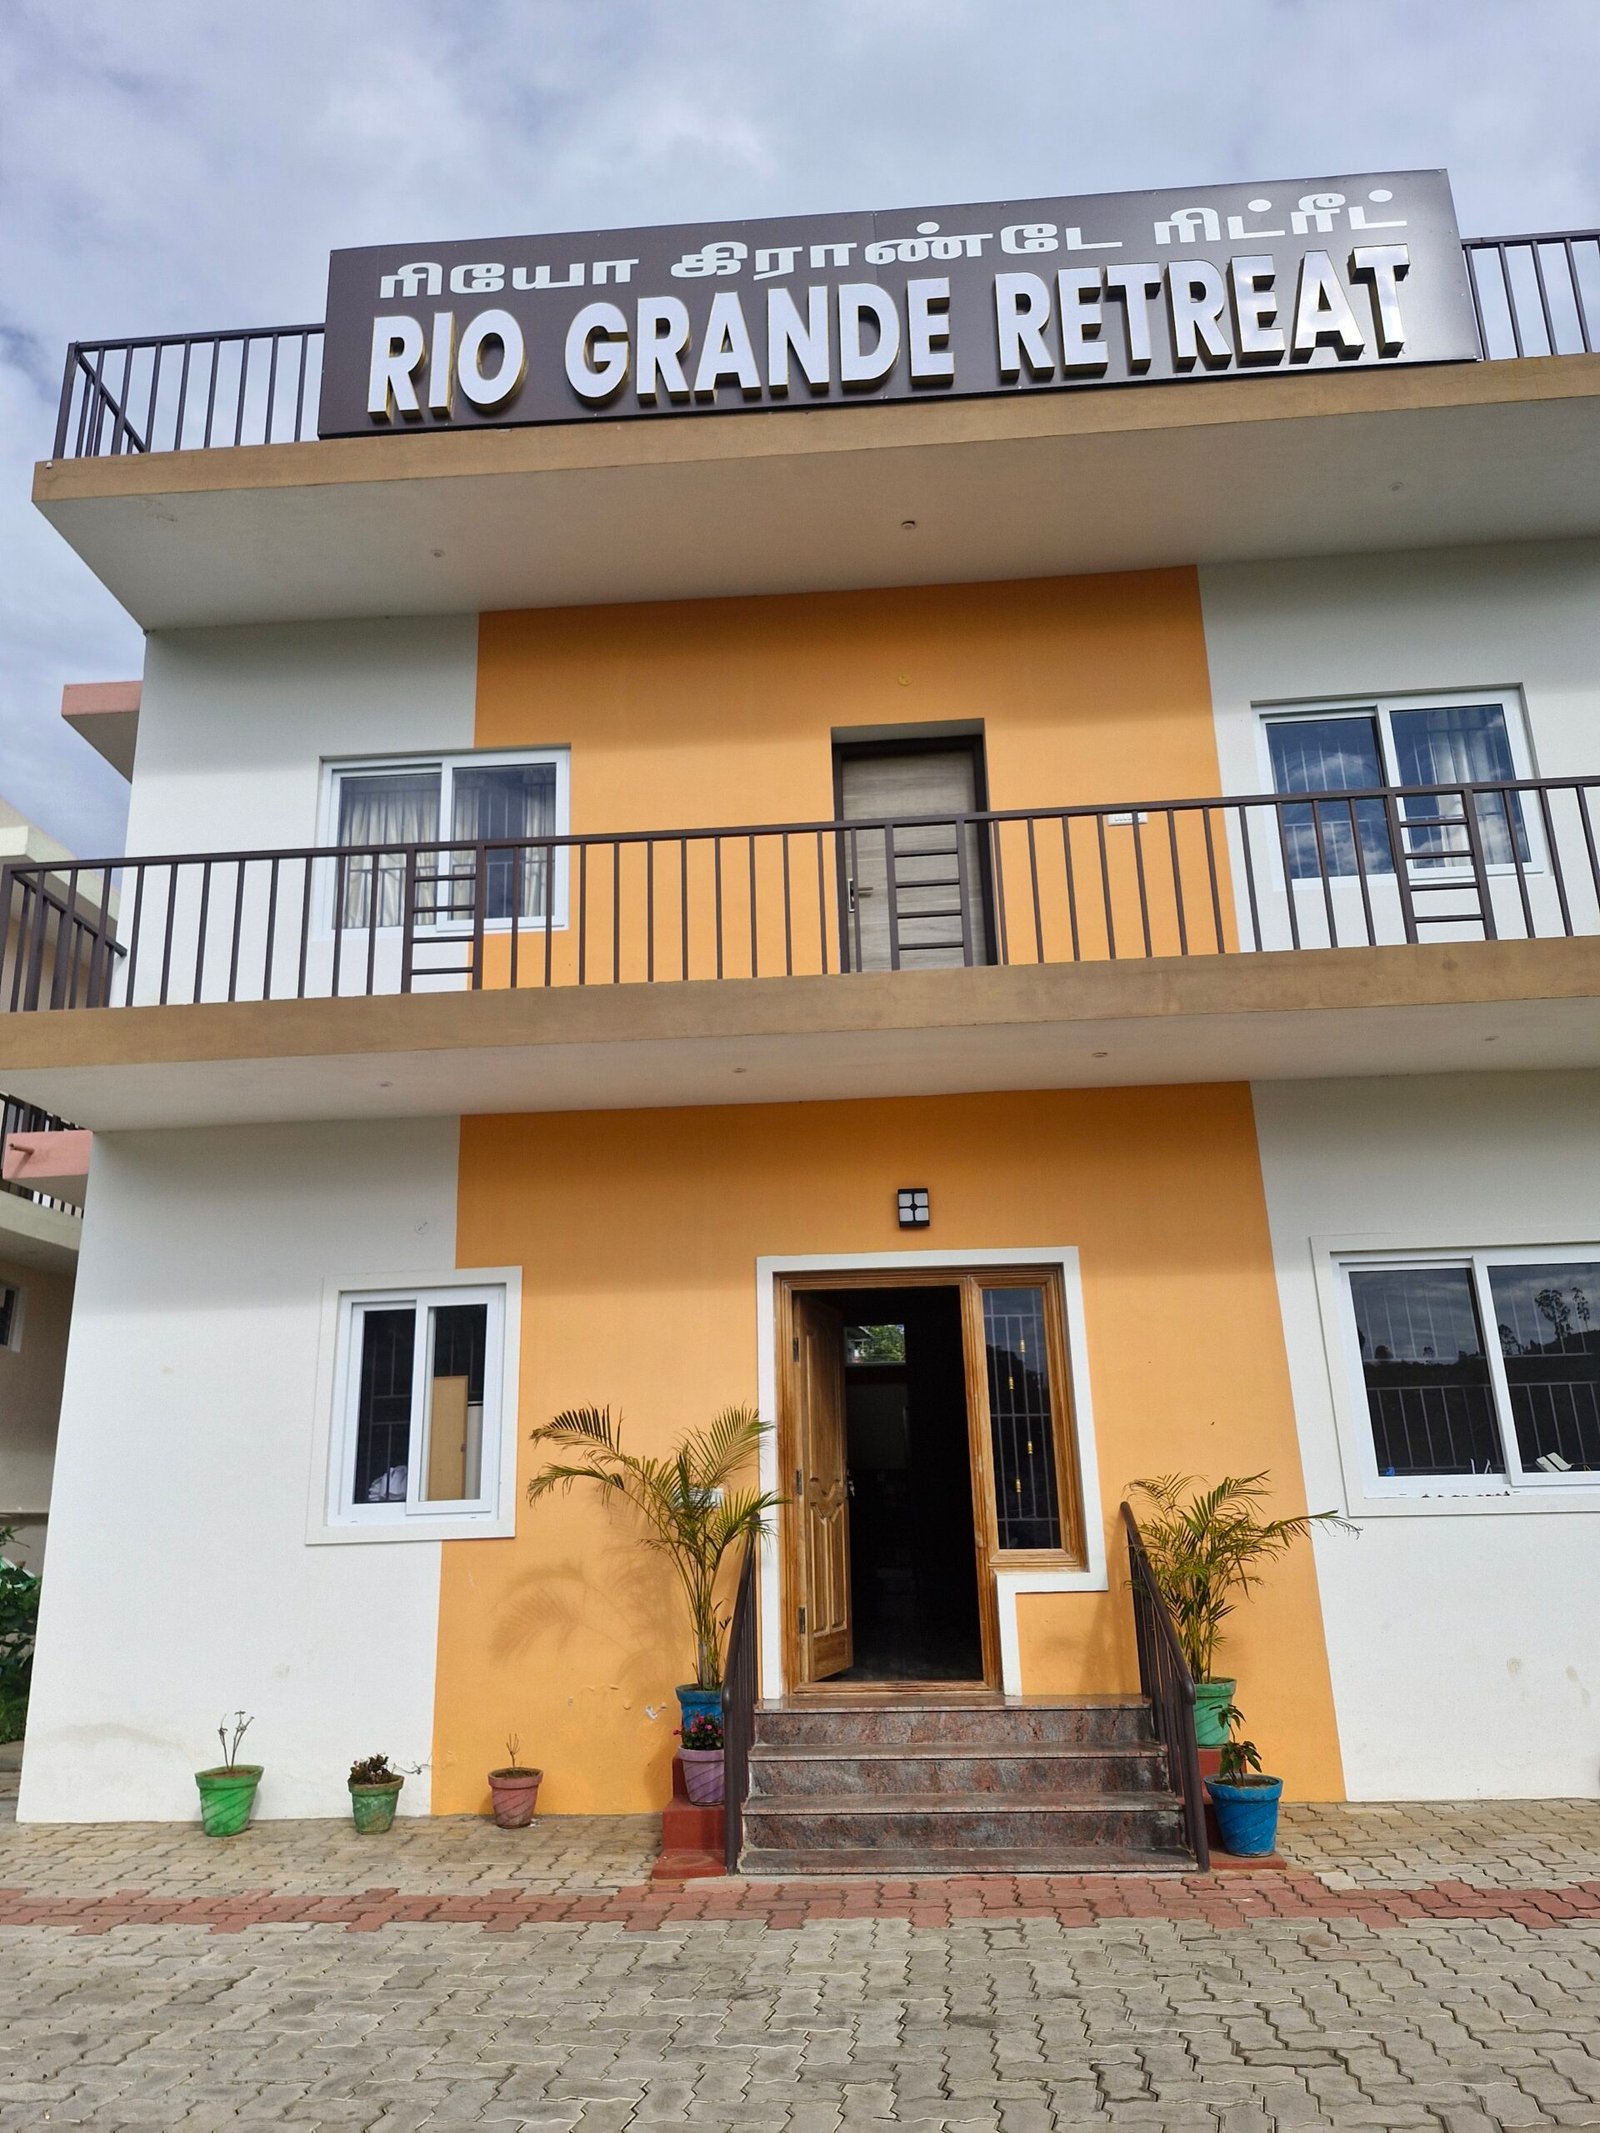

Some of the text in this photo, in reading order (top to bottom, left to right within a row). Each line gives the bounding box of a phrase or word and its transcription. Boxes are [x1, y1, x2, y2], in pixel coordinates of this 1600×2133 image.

[380, 261, 640, 299] ரியோ
[671, 221, 1123, 281] கிராண்டே
[366, 244, 1410, 417] RIO GRANDE RETREAT
